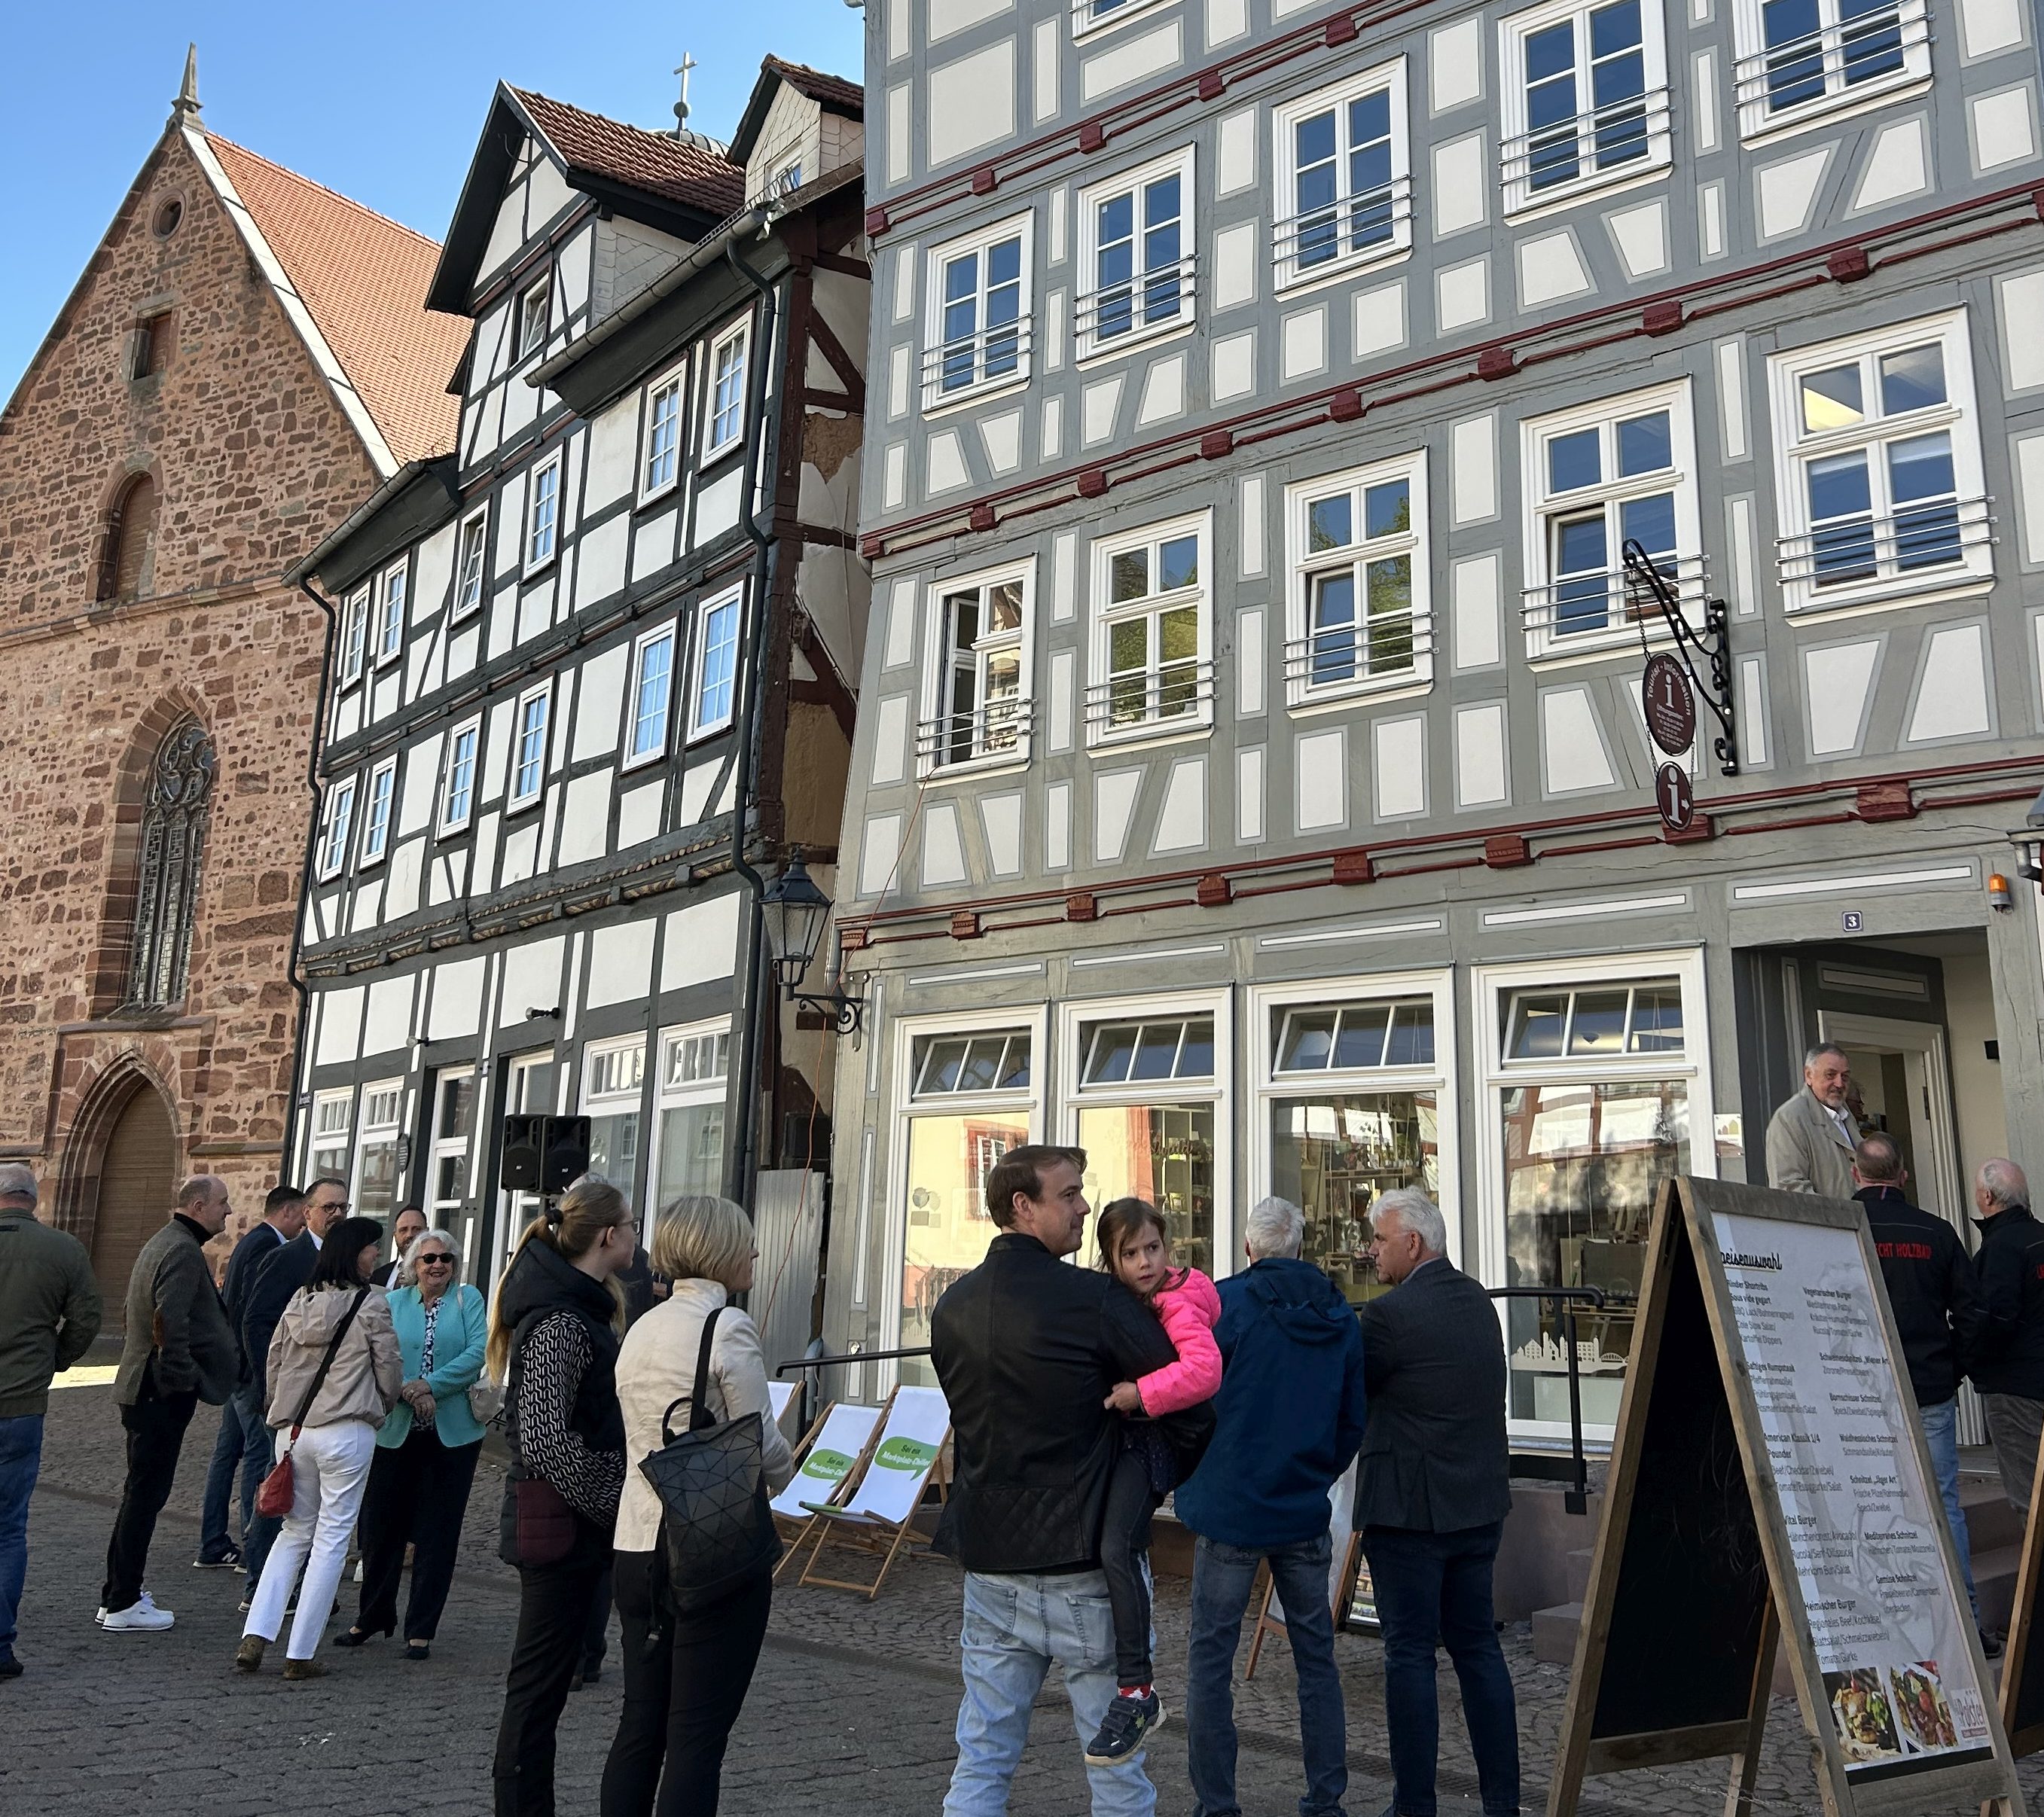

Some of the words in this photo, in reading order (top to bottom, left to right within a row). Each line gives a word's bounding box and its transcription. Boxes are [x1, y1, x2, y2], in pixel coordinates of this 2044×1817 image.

[1647, 664, 1661, 699] Tourist
[1663, 661, 1691, 716] Information
[1848, 915, 1857, 927] 3
[1797, 1515, 1817, 1528] Burger
[1837, 1598, 1856, 1611] Burger
